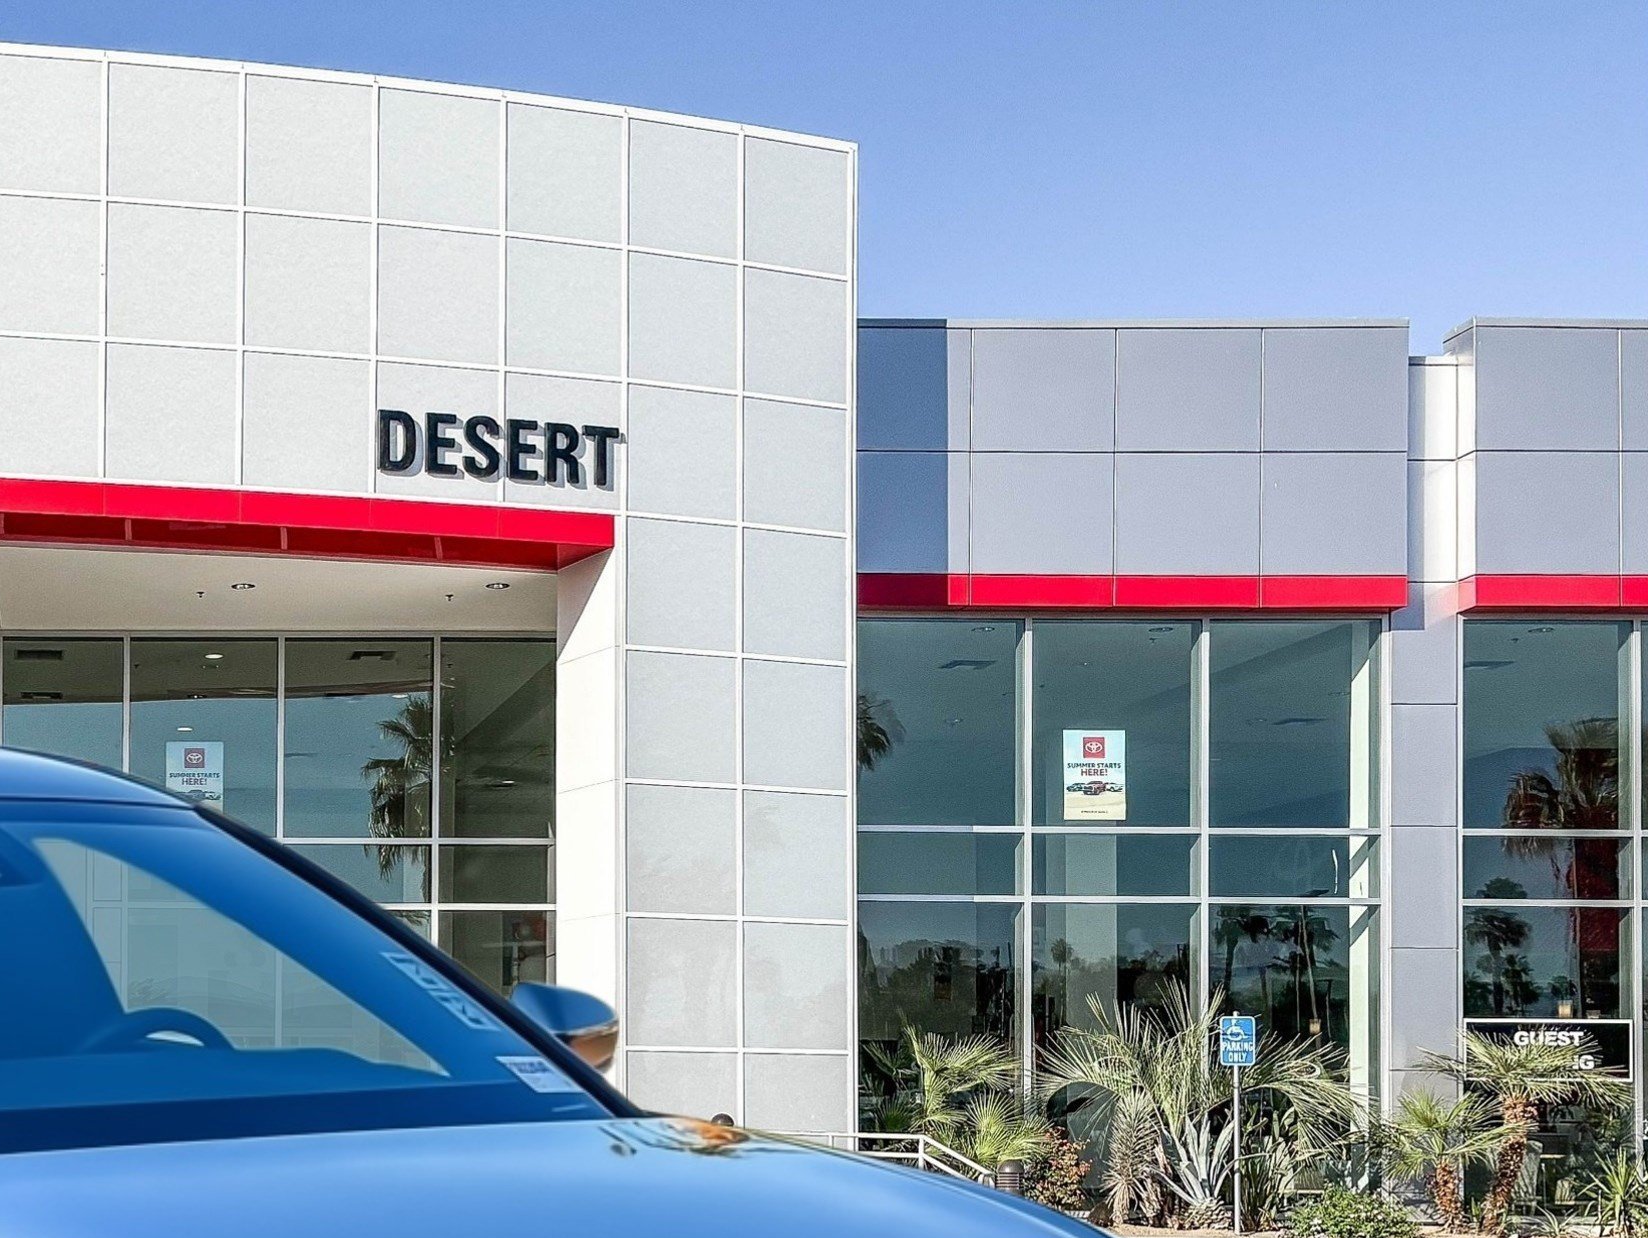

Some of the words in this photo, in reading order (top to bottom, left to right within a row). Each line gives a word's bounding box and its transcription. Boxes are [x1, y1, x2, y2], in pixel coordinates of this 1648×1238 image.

[377, 409, 620, 487] DESERT
[1080, 768, 1108, 777] HERE!
[181, 778, 207, 786] HERE!
[1513, 1030, 1584, 1046] GUEST
[1222, 1041, 1254, 1052] PARKING
[1228, 1052, 1247, 1062] ONLY
